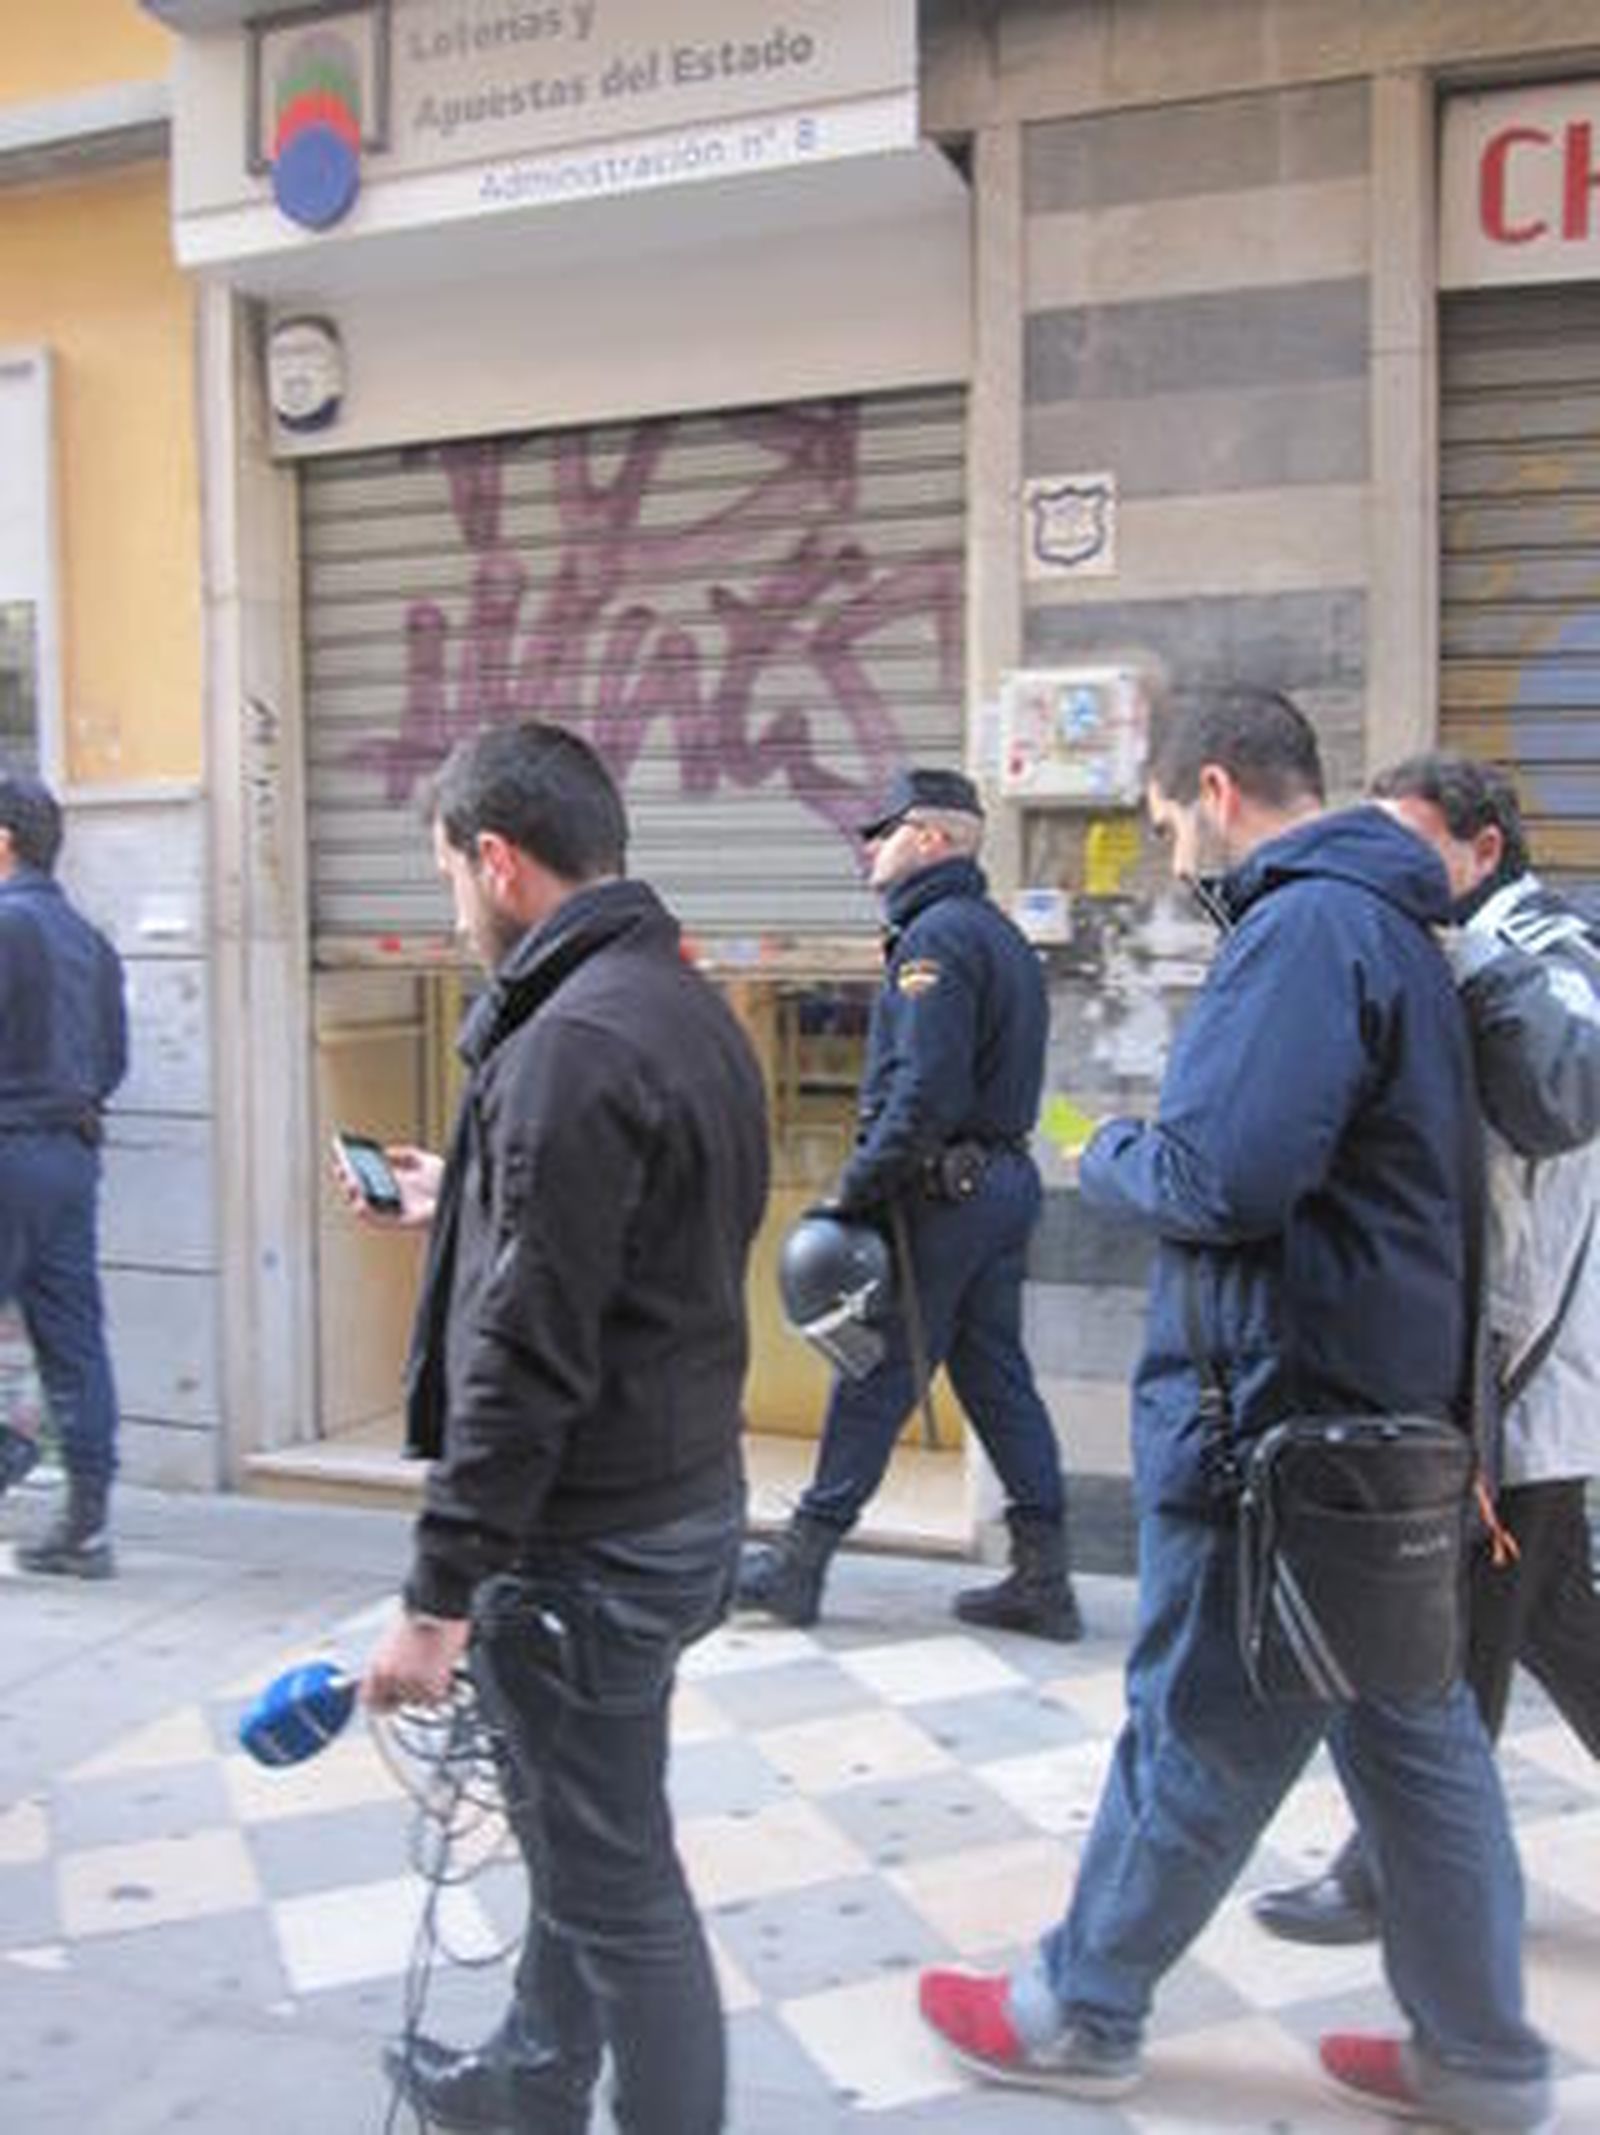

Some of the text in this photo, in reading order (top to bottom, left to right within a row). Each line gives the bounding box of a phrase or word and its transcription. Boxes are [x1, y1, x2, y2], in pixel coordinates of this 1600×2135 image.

[571, 0, 596, 40] y
[412, 26, 815, 138] Apuestas del Estado
[797, 117, 816, 152] 8
